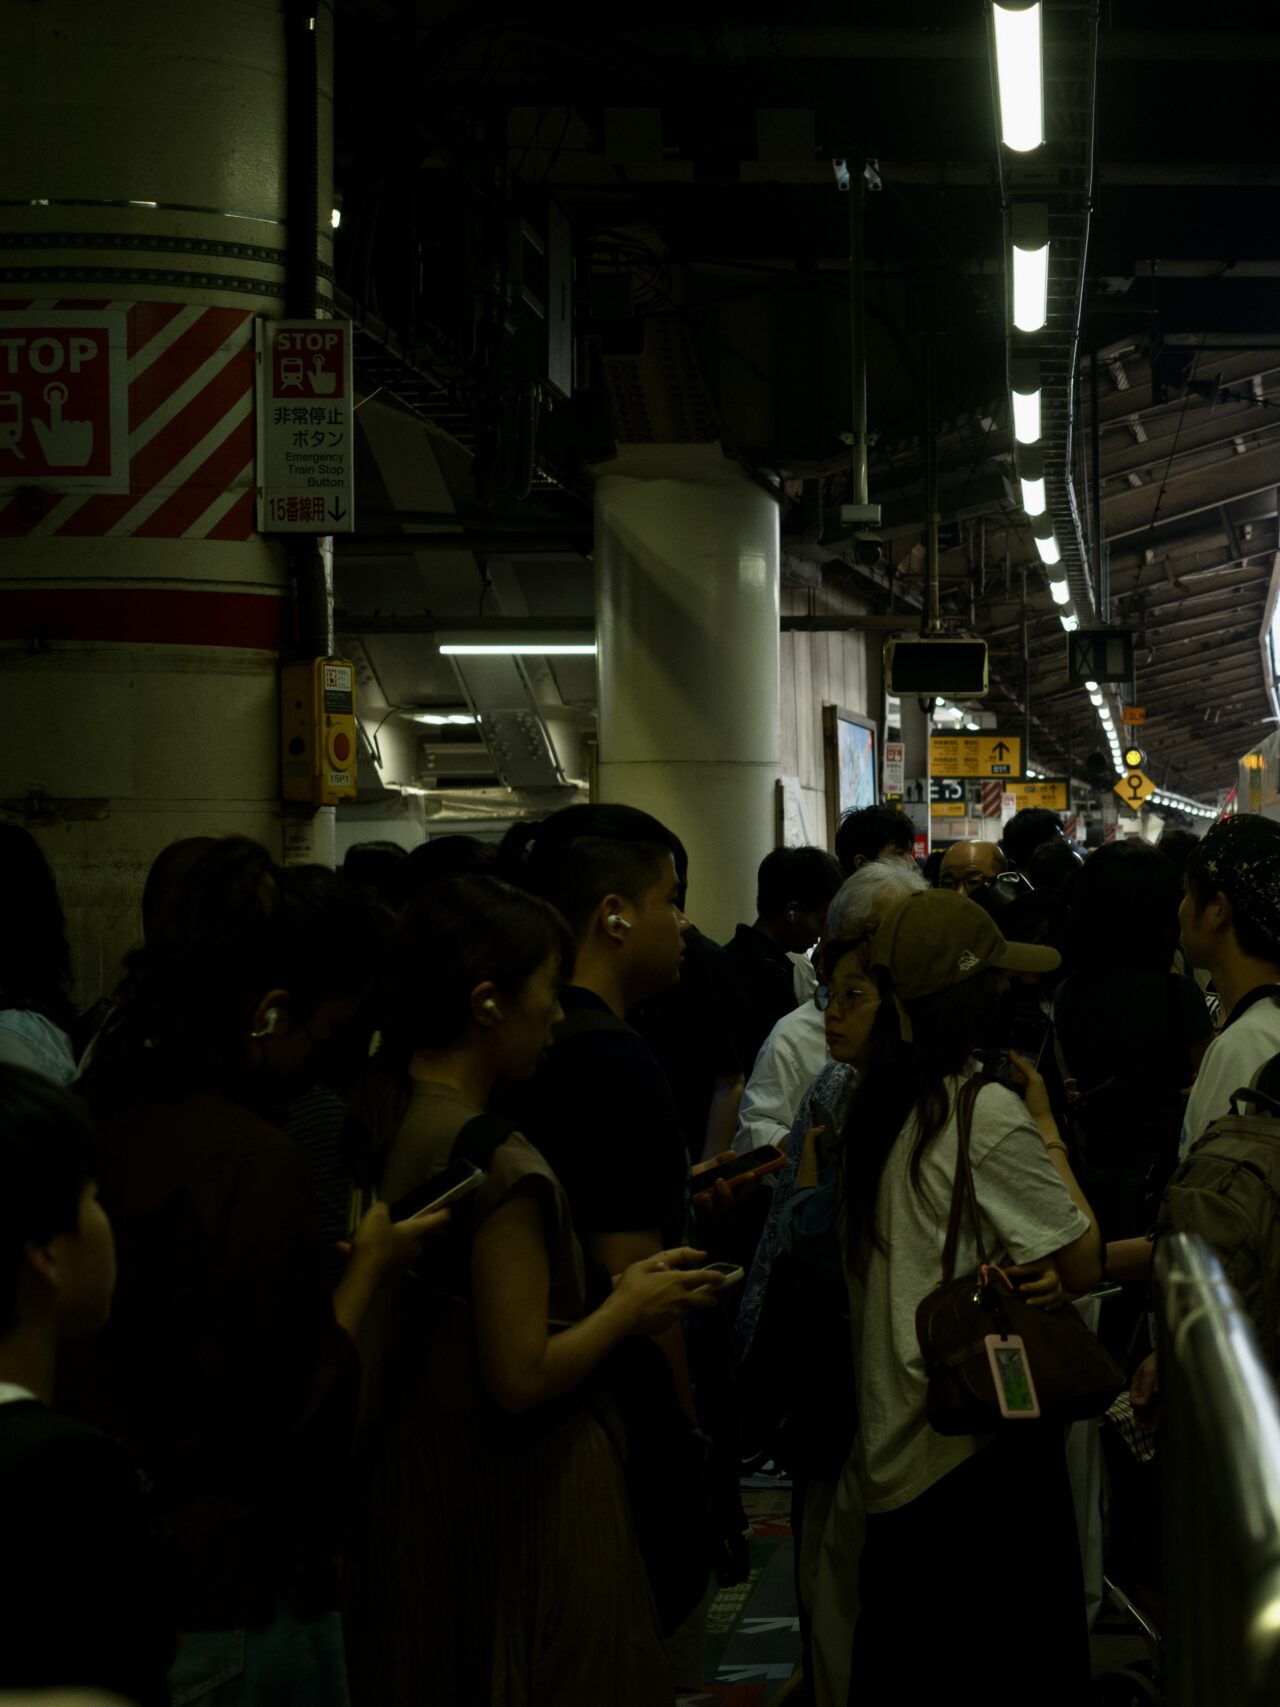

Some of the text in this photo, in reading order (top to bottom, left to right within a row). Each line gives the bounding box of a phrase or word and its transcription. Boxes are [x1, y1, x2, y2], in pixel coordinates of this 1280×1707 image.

[278, 333, 338, 351] STOP
[0, 336, 98, 375] TOP
[274, 406, 344, 425] 非常停止
[293, 429, 344, 448] ボタン
[286, 452, 344, 464] Emergency
[287, 464, 344, 476] Train Stop
[307, 477, 344, 488] Button
[269, 496, 325, 523] 15番線用
